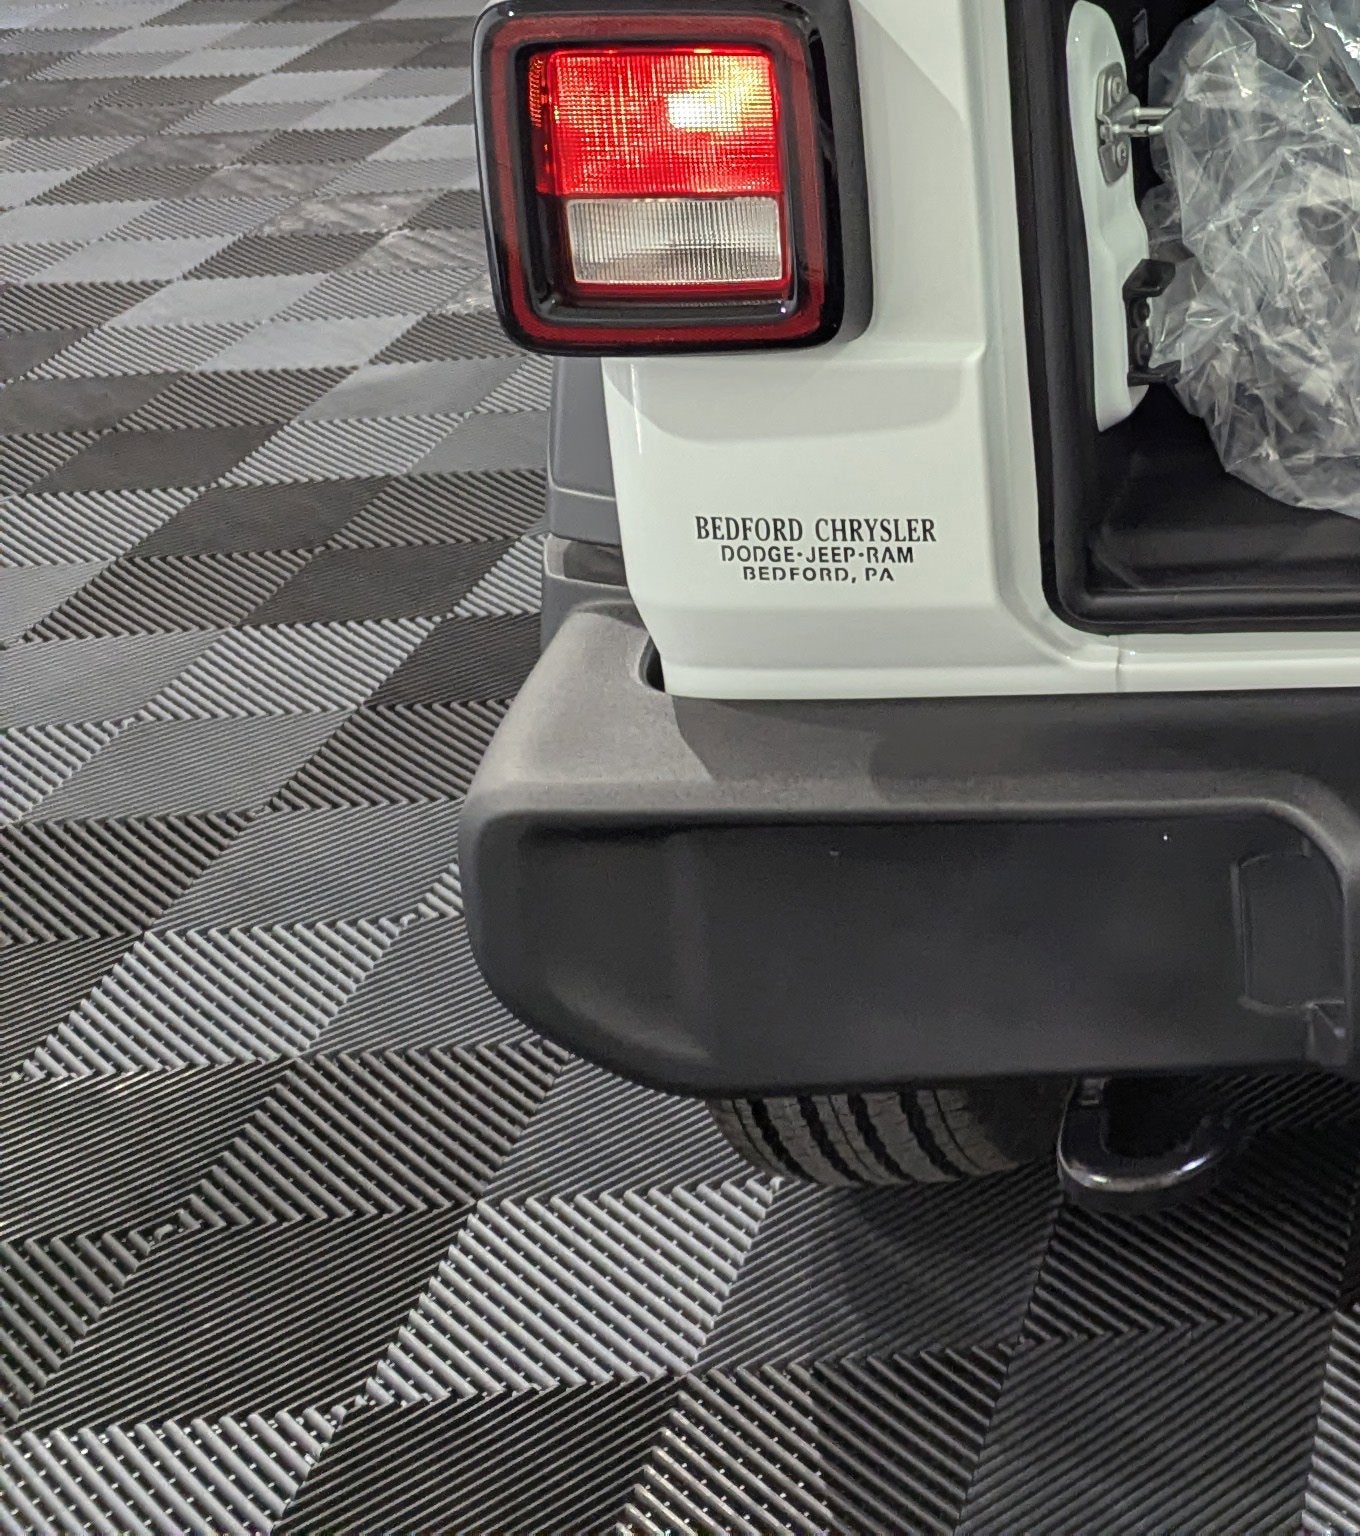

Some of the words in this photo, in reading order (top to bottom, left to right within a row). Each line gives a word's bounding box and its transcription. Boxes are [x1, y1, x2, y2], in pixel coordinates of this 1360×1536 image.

[695, 516, 802, 542] BEDFORD
[815, 517, 936, 542] CHRYSLER
[743, 566, 856, 583] BEDFORD,
[865, 567, 895, 582] PA
